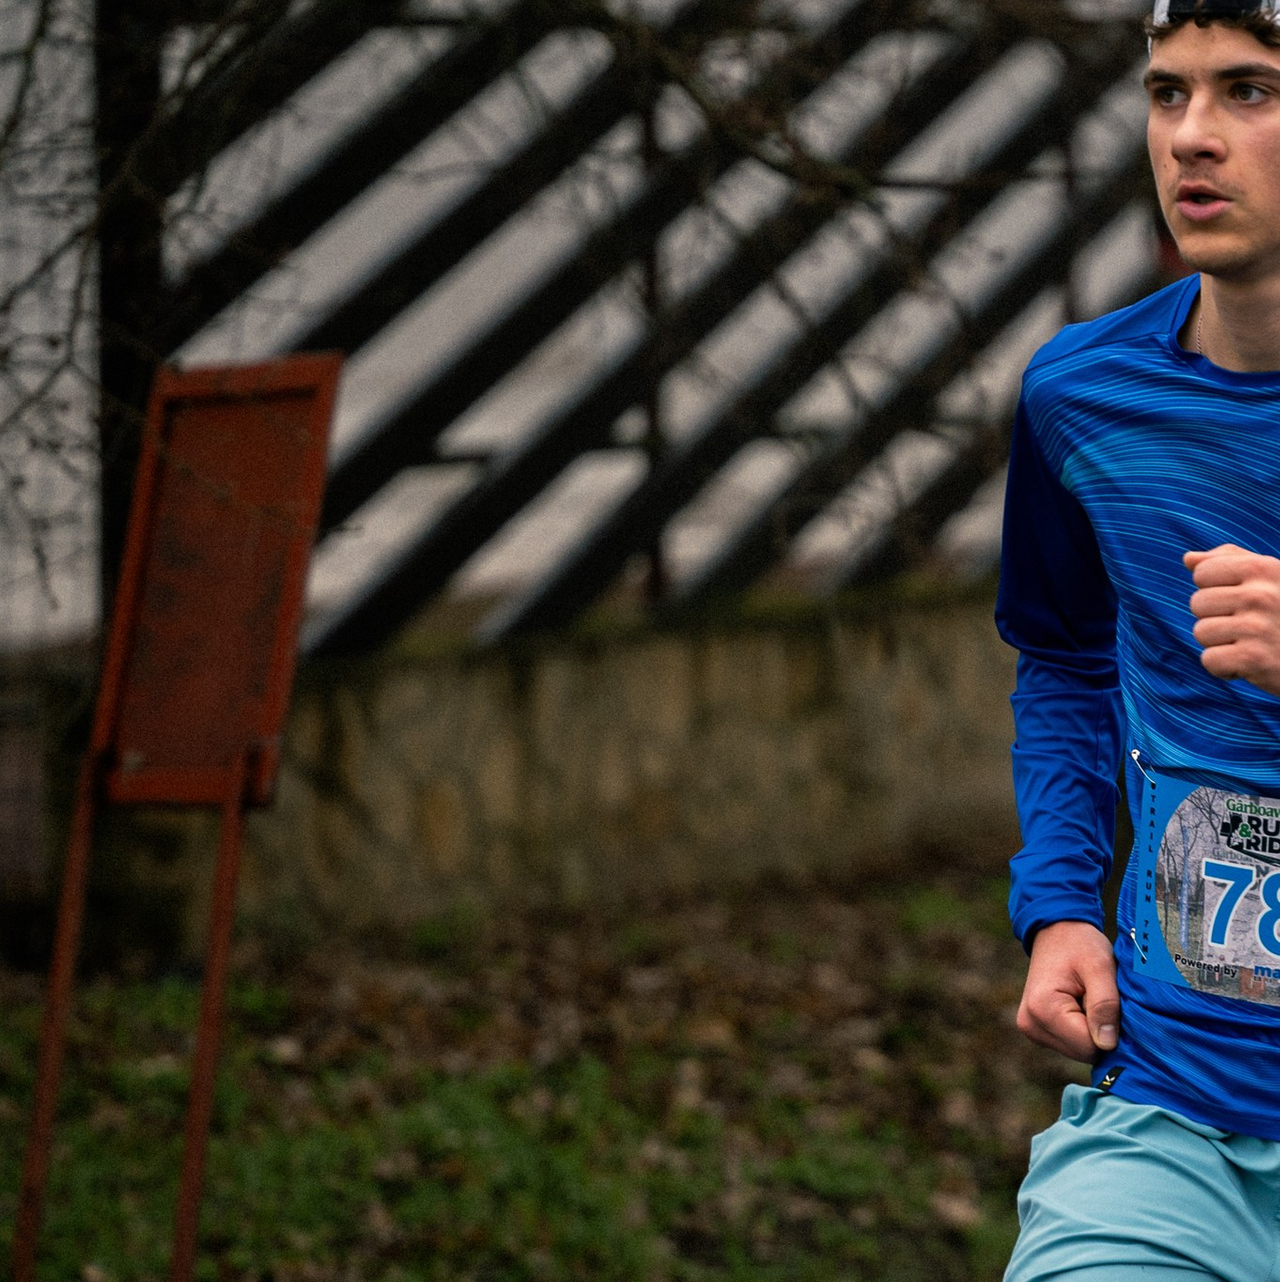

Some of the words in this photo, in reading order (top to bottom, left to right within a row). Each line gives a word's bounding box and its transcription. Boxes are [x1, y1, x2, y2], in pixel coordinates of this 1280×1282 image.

[1148, 795, 1157, 853] TRAIL
[1174, 953, 1220, 973] Powered
[1223, 964, 1238, 979] by
